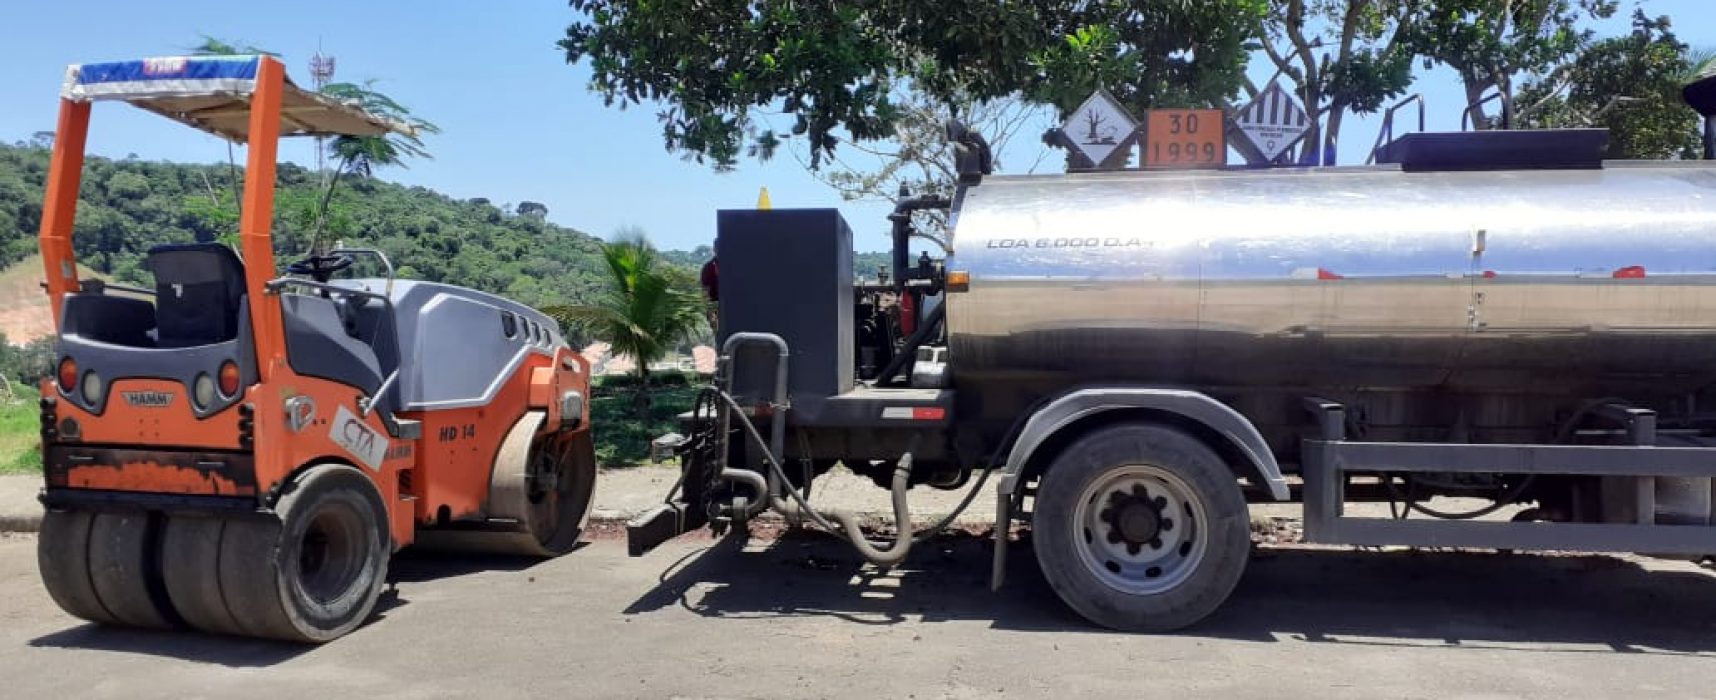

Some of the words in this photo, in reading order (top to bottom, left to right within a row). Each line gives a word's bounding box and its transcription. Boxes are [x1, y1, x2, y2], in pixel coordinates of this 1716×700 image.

[1169, 113, 1198, 134] 30
[1154, 142, 1216, 162] 1999
[1266, 140, 1276, 152] 9
[128, 393, 167, 405] HAMM
[439, 426, 457, 442] HD
[462, 424, 475, 439] 14
